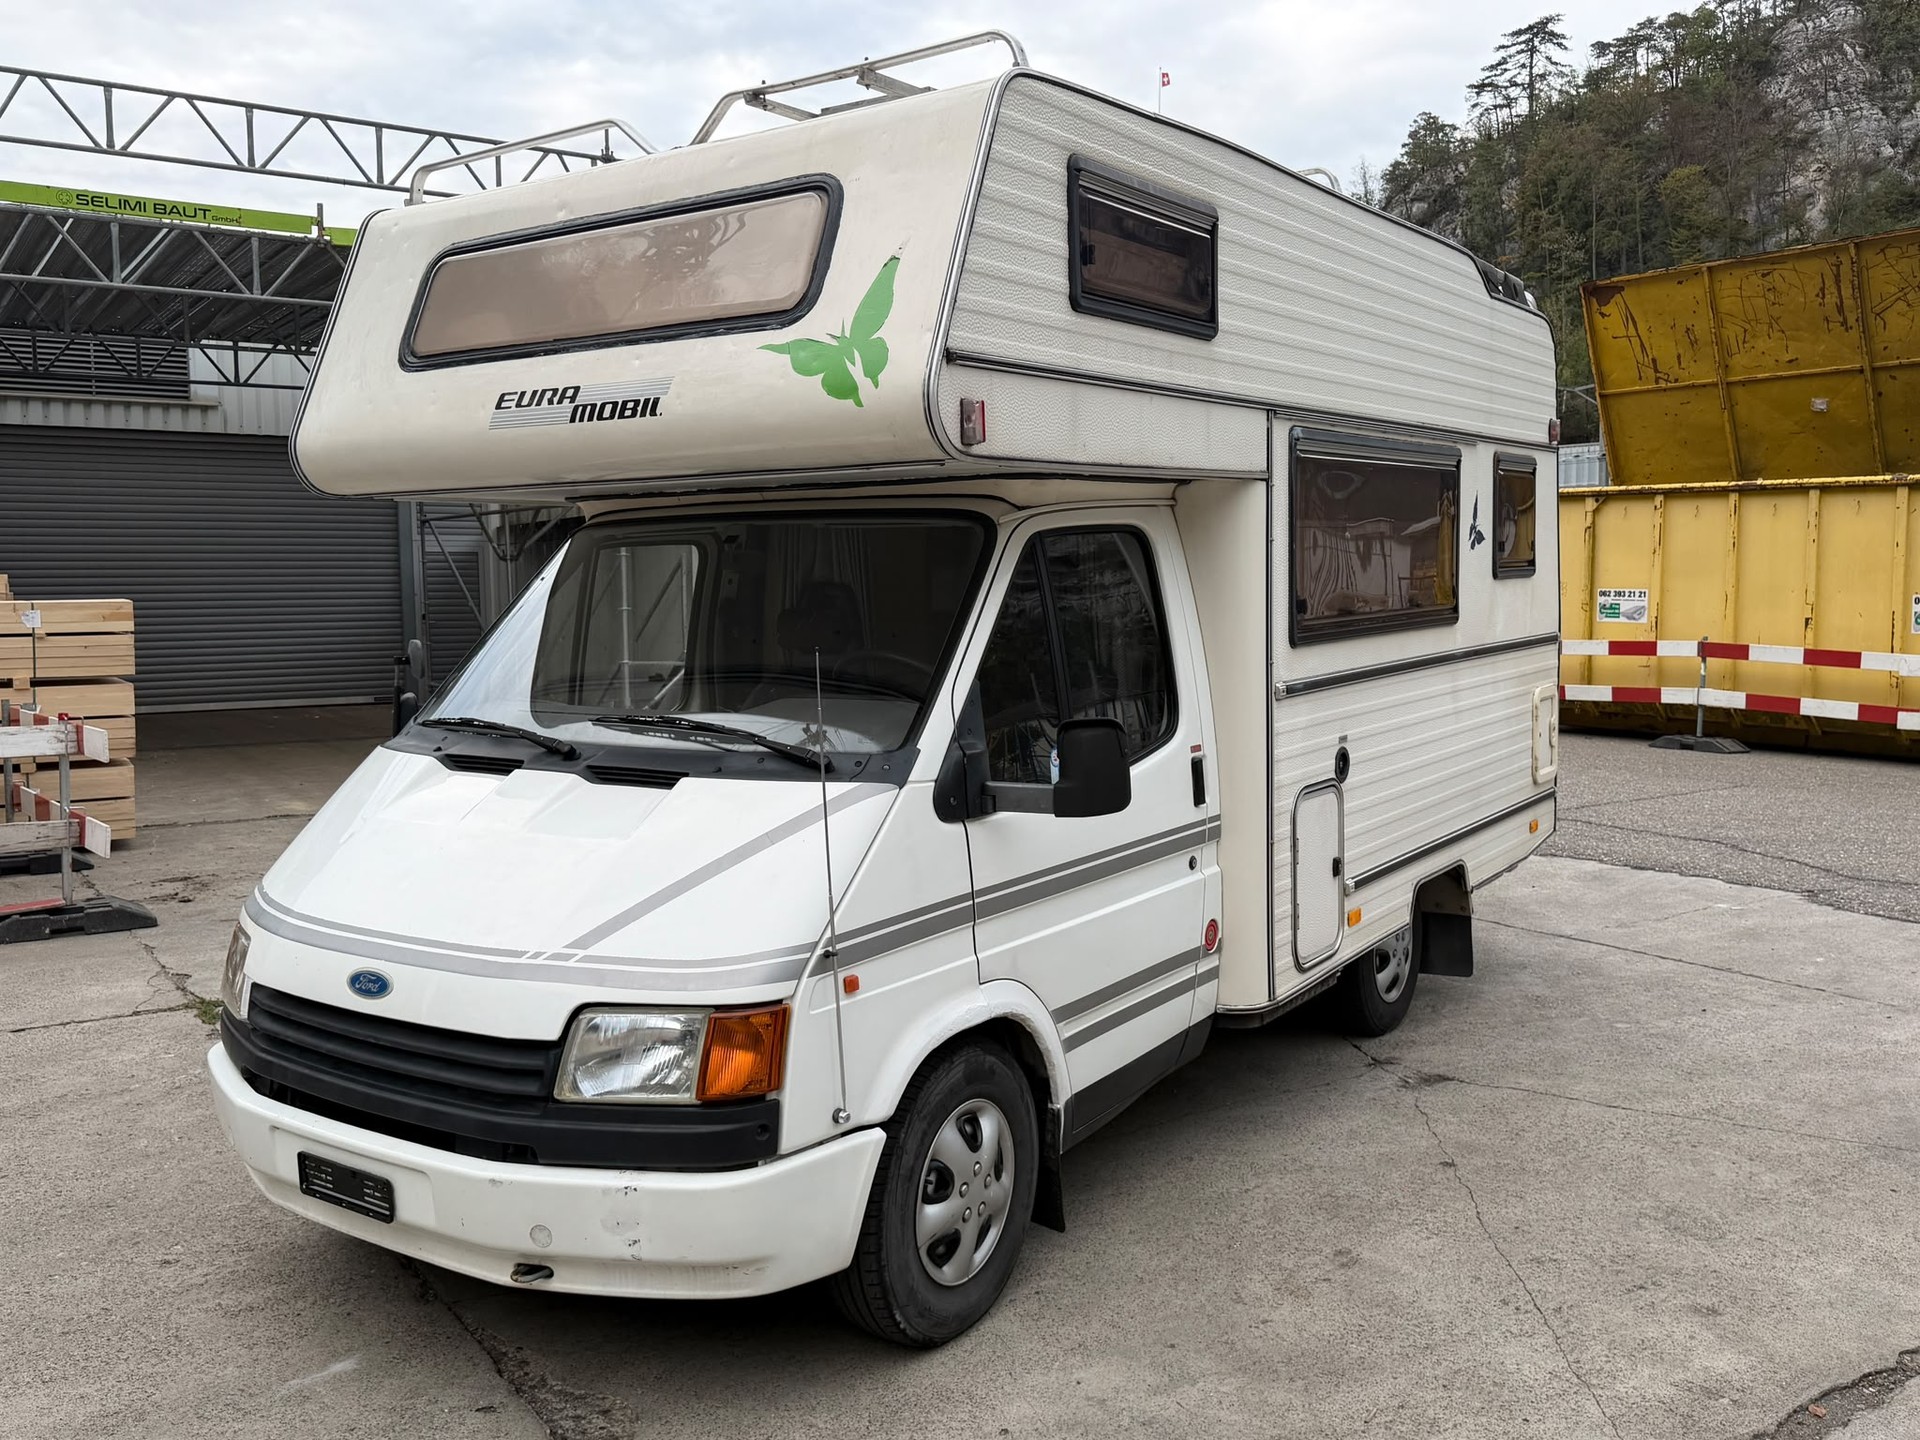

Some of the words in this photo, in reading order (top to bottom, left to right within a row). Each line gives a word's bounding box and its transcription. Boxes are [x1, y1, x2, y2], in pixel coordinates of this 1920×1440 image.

[76, 194, 147, 212] SELIMI
[153, 203, 211, 220] BAUT
[212, 215, 238, 223] GmbH
[495, 385, 581, 410] EURA
[1613, 590, 1626, 598] 393
[356, 973, 382, 992] Ford
